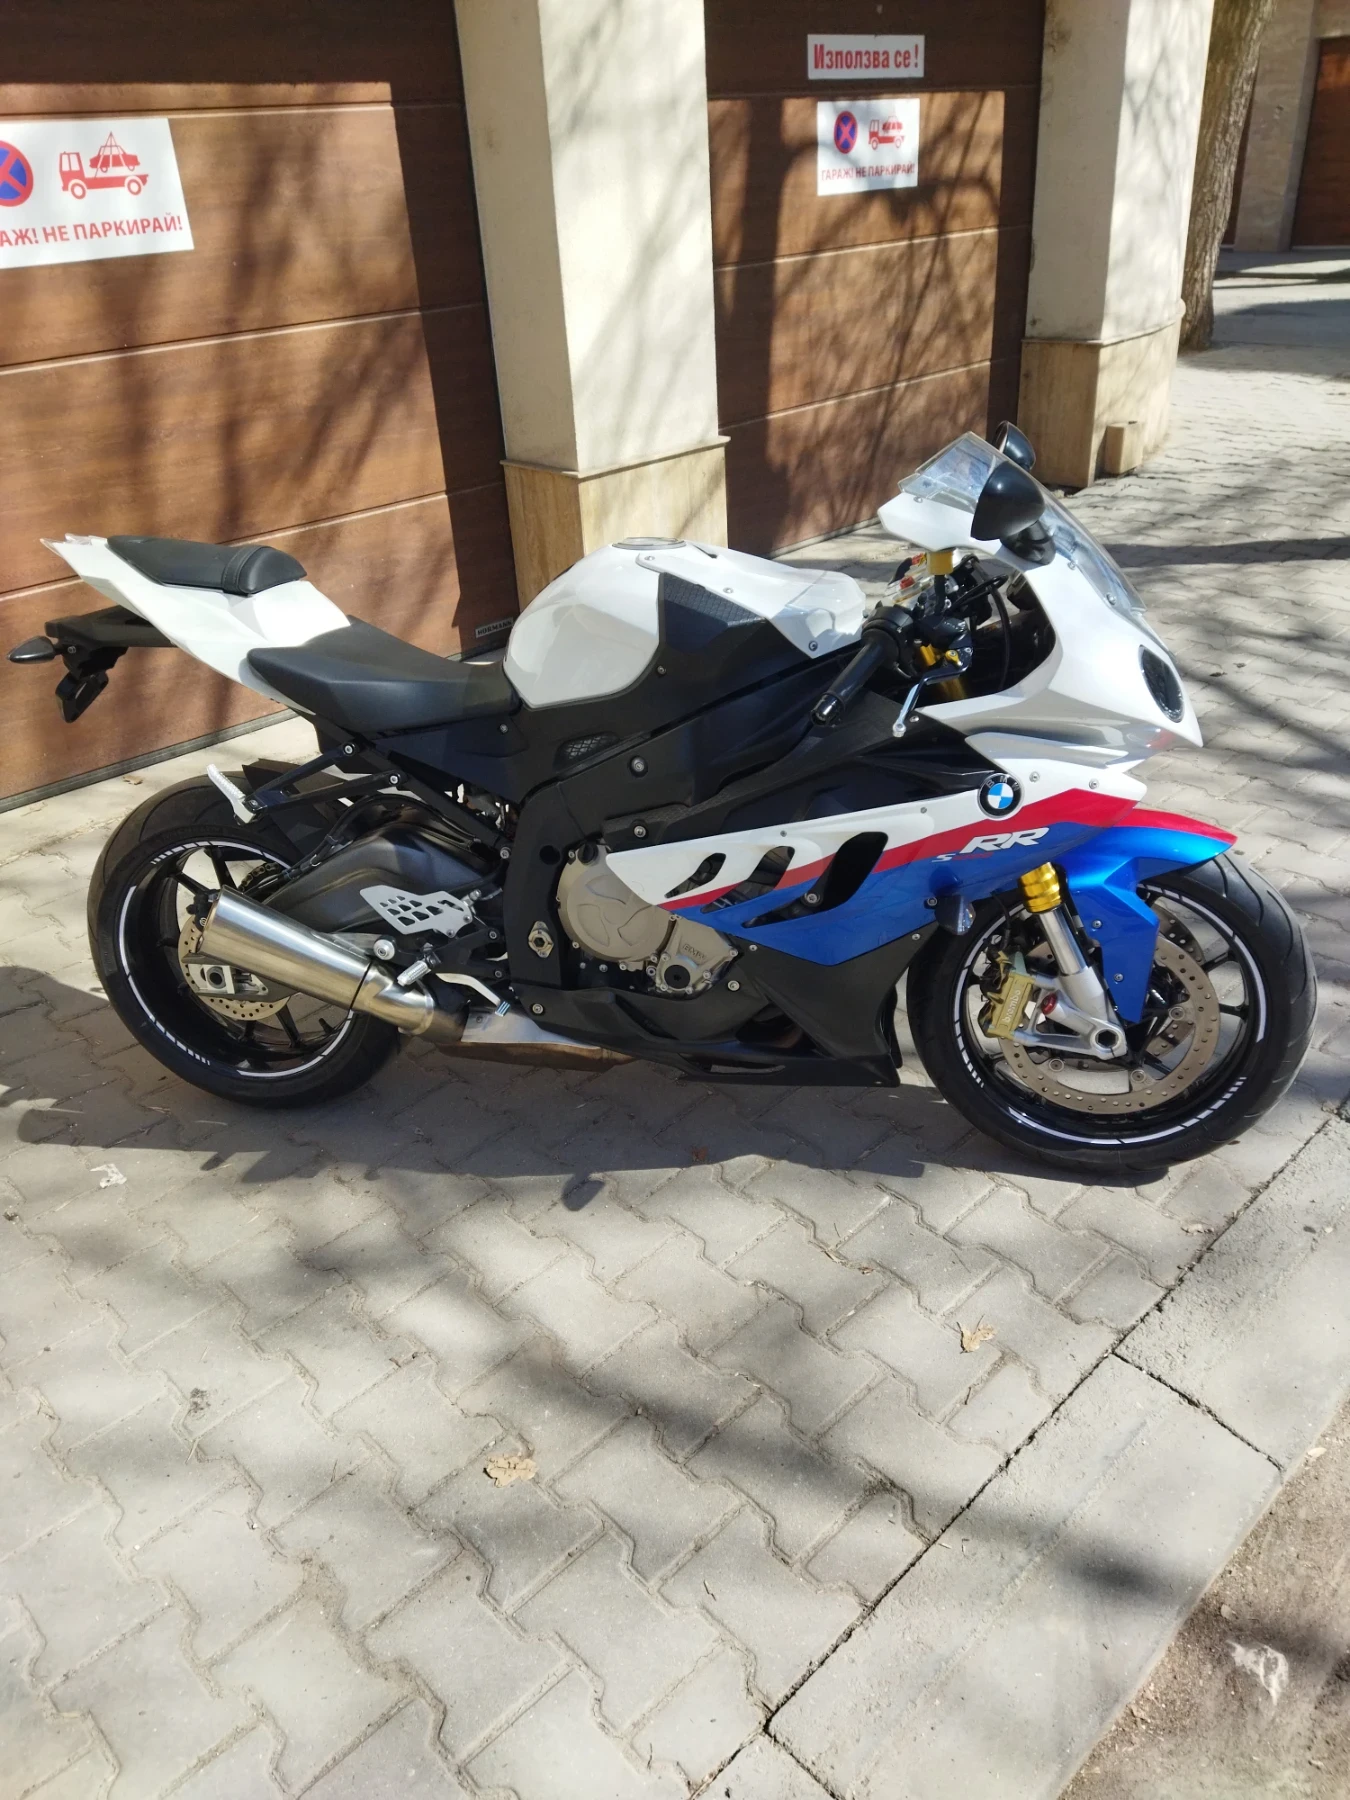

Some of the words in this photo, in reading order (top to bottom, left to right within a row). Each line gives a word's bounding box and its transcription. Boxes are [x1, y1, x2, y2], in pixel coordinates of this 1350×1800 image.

[813, 43, 890, 70] Използва
[821, 167, 854, 181] ГАРАЖ!
[855, 166, 867, 178] НЕ
[868, 161, 915, 177] ПАРКИРАЙ!
[42, 225, 70, 243] НЕ
[73, 212, 183, 240] ПАРКИРАЙ!
[985, 775, 1020, 792] BMW
[959, 827, 1050, 854] RR
